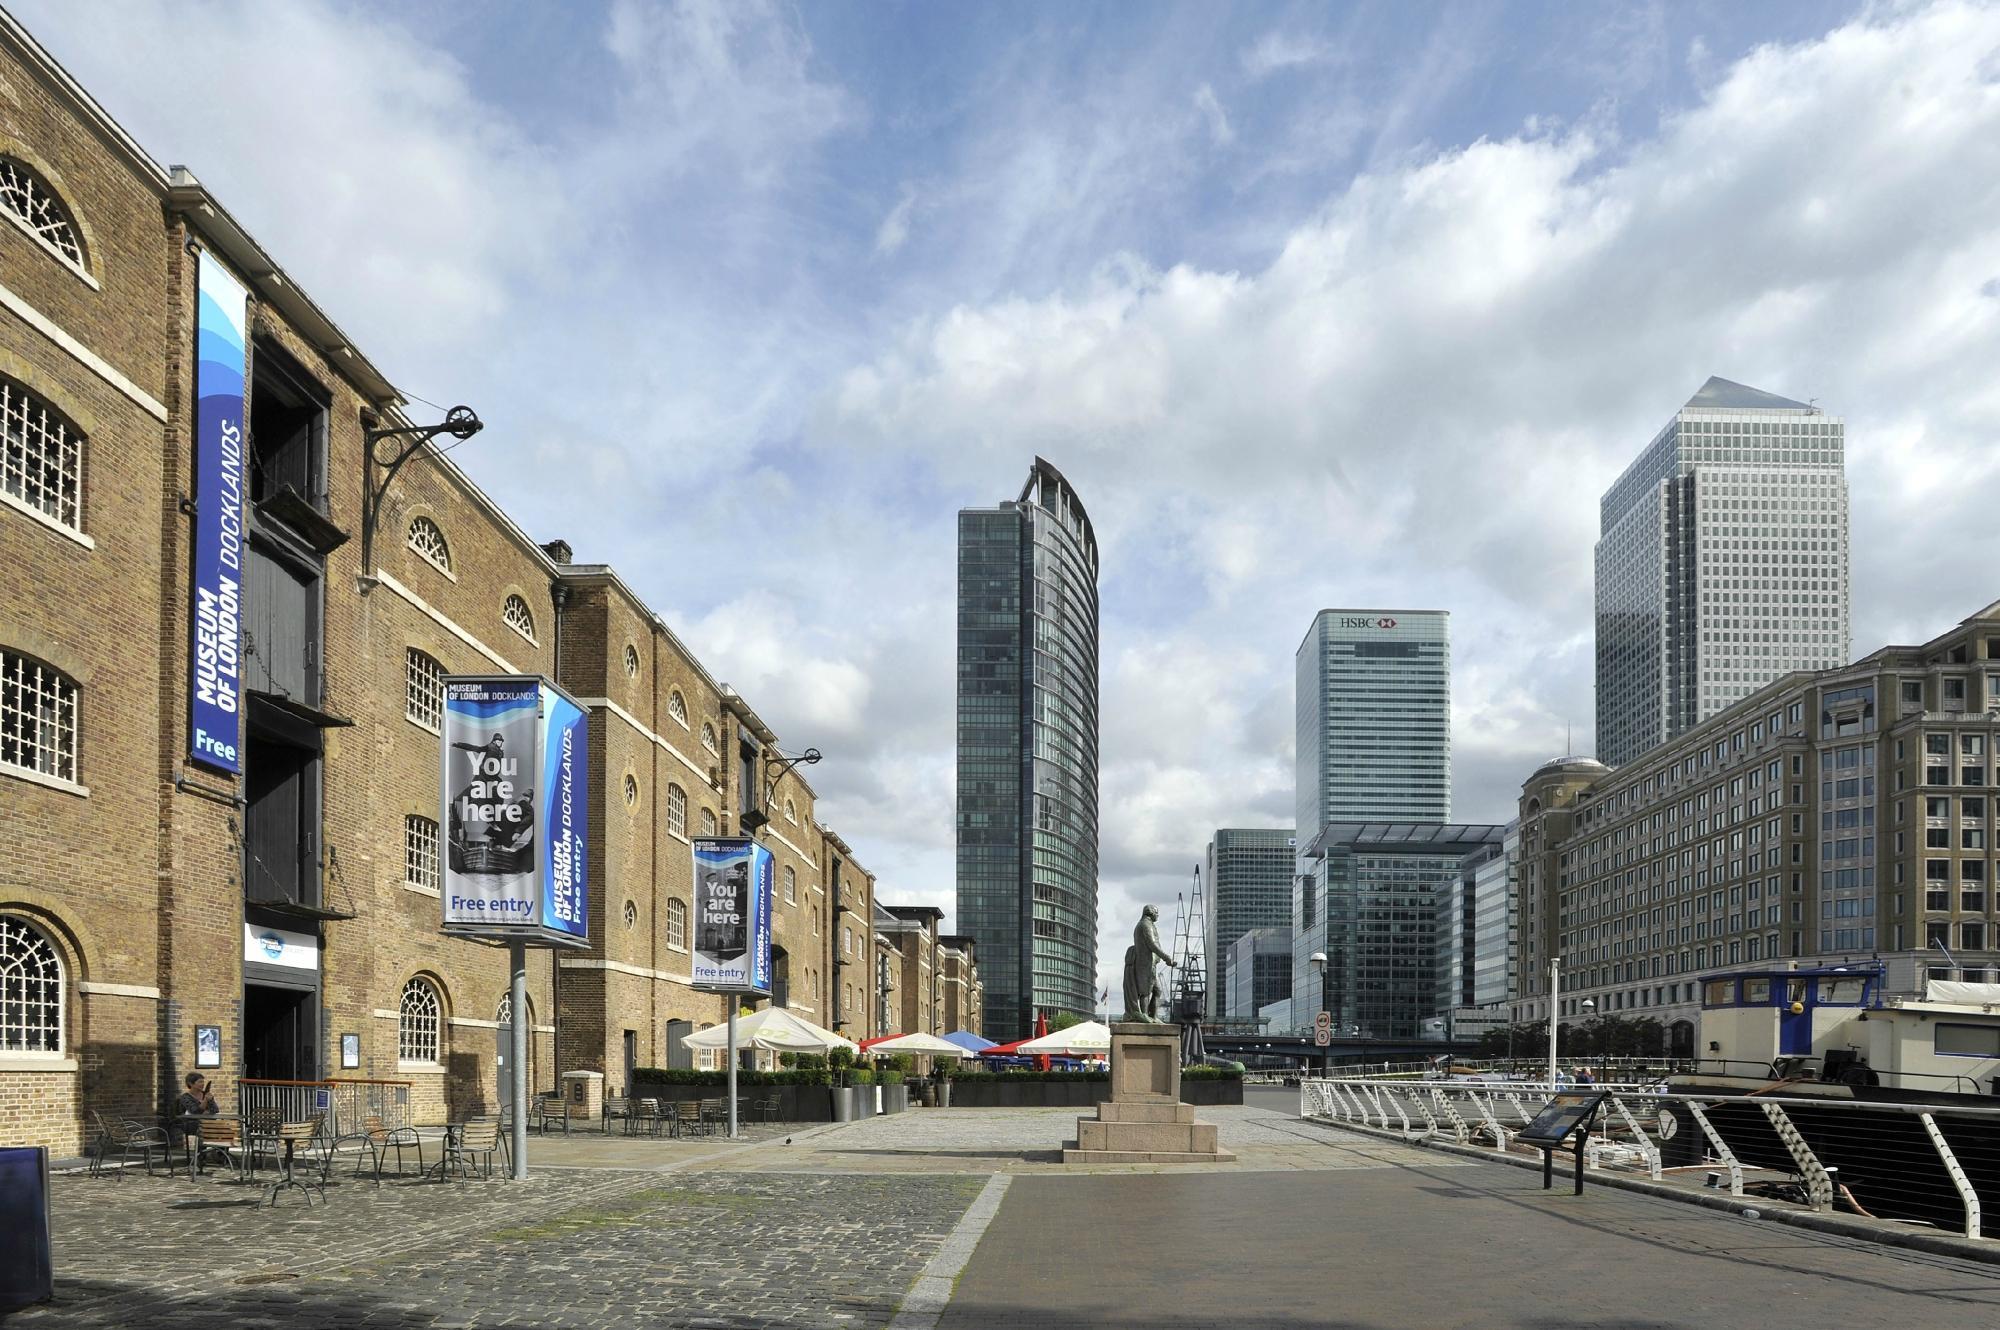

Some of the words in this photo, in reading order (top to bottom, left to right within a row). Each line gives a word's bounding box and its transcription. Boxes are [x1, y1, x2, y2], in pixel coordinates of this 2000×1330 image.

[219, 419, 242, 570] DOCKLANDS
[218, 579, 239, 672] LONDON
[1341, 617, 1375, 628] HSBC
[197, 586, 218, 705] MUSEUM
[218, 677, 237, 713] OF
[449, 684, 482, 692] MUSEUM
[449, 692, 459, 700] OF
[460, 692, 489, 700] LONDON
[492, 692, 535, 700] DOCKLANDS
[195, 727, 236, 762] Free
[466, 751, 517, 776] You
[471, 780, 514, 799] are
[562, 727, 572, 827] DOCKLANDS
[462, 796, 522, 823] here
[562, 828, 572, 896] LONDON
[573, 834, 583, 883] entry
[553, 840, 563, 919] MUSEUM
[706, 881, 737, 897] You
[451, 895, 485, 911] Free
[490, 898, 534, 916] entry
[562, 899, 572, 921] OF
[573, 888, 582, 924] Free
[703, 907, 740, 924] here
[708, 898, 735, 911] are
[695, 967, 717, 977] Free
[718, 968, 746, 979] entry
